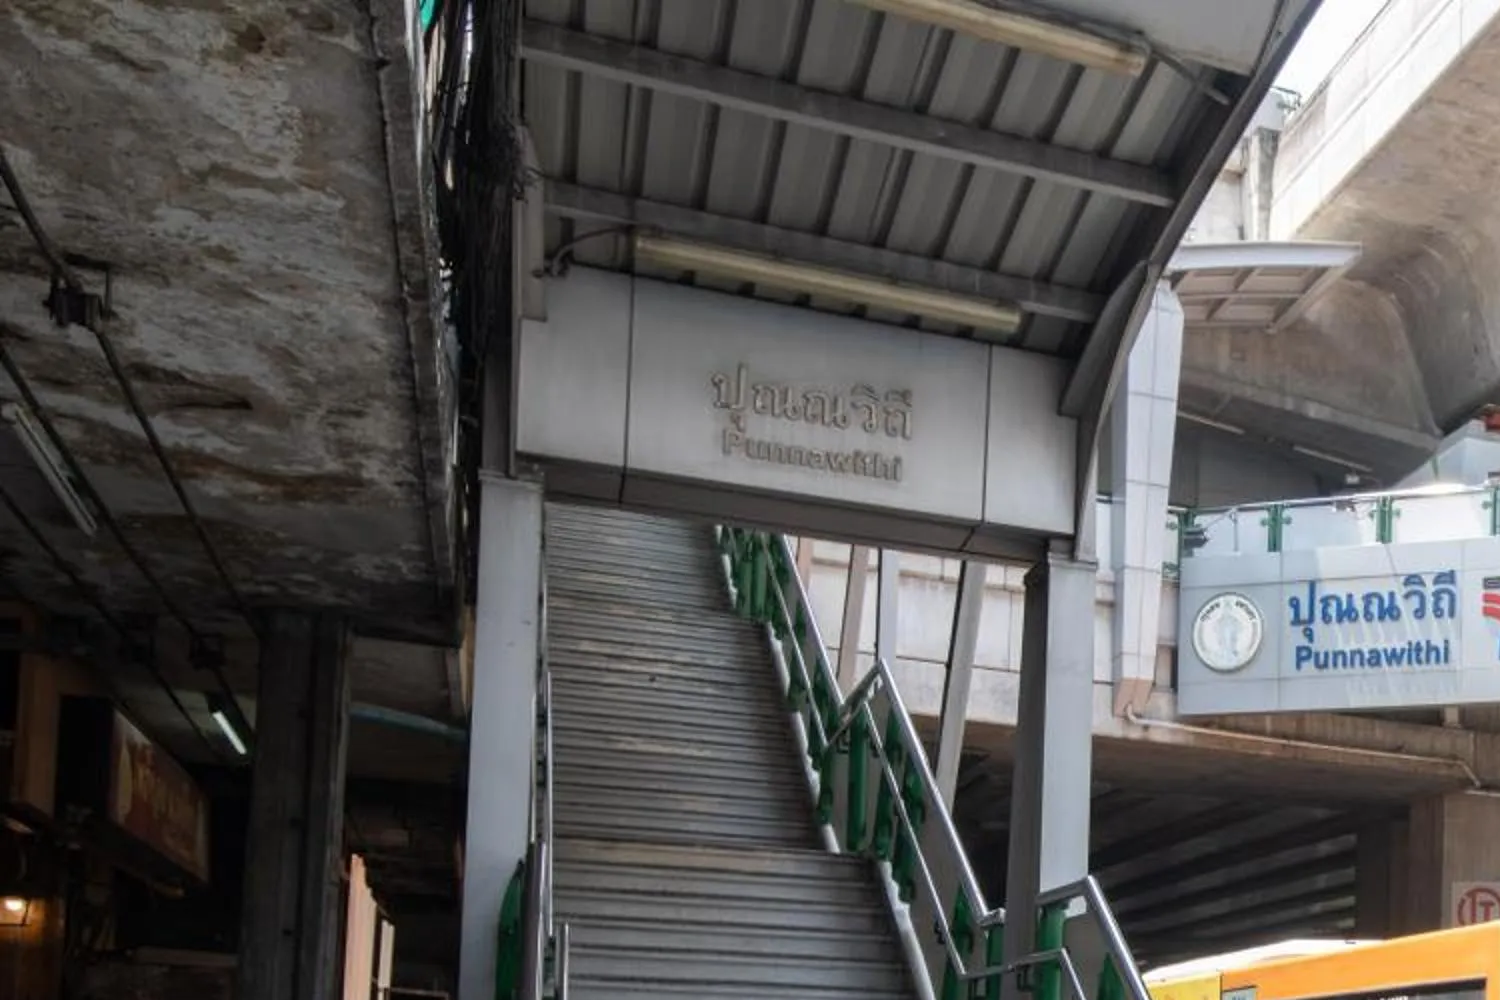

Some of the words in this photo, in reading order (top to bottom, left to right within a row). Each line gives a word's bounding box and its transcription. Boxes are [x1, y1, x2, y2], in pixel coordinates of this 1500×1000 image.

[711, 362, 914, 440] ปุณณวิถี
[721, 429, 903, 482] Punnawithi
[1287, 569, 1458, 643] ปุณณวิถี
[1294, 638, 1451, 672] Punnawithi
